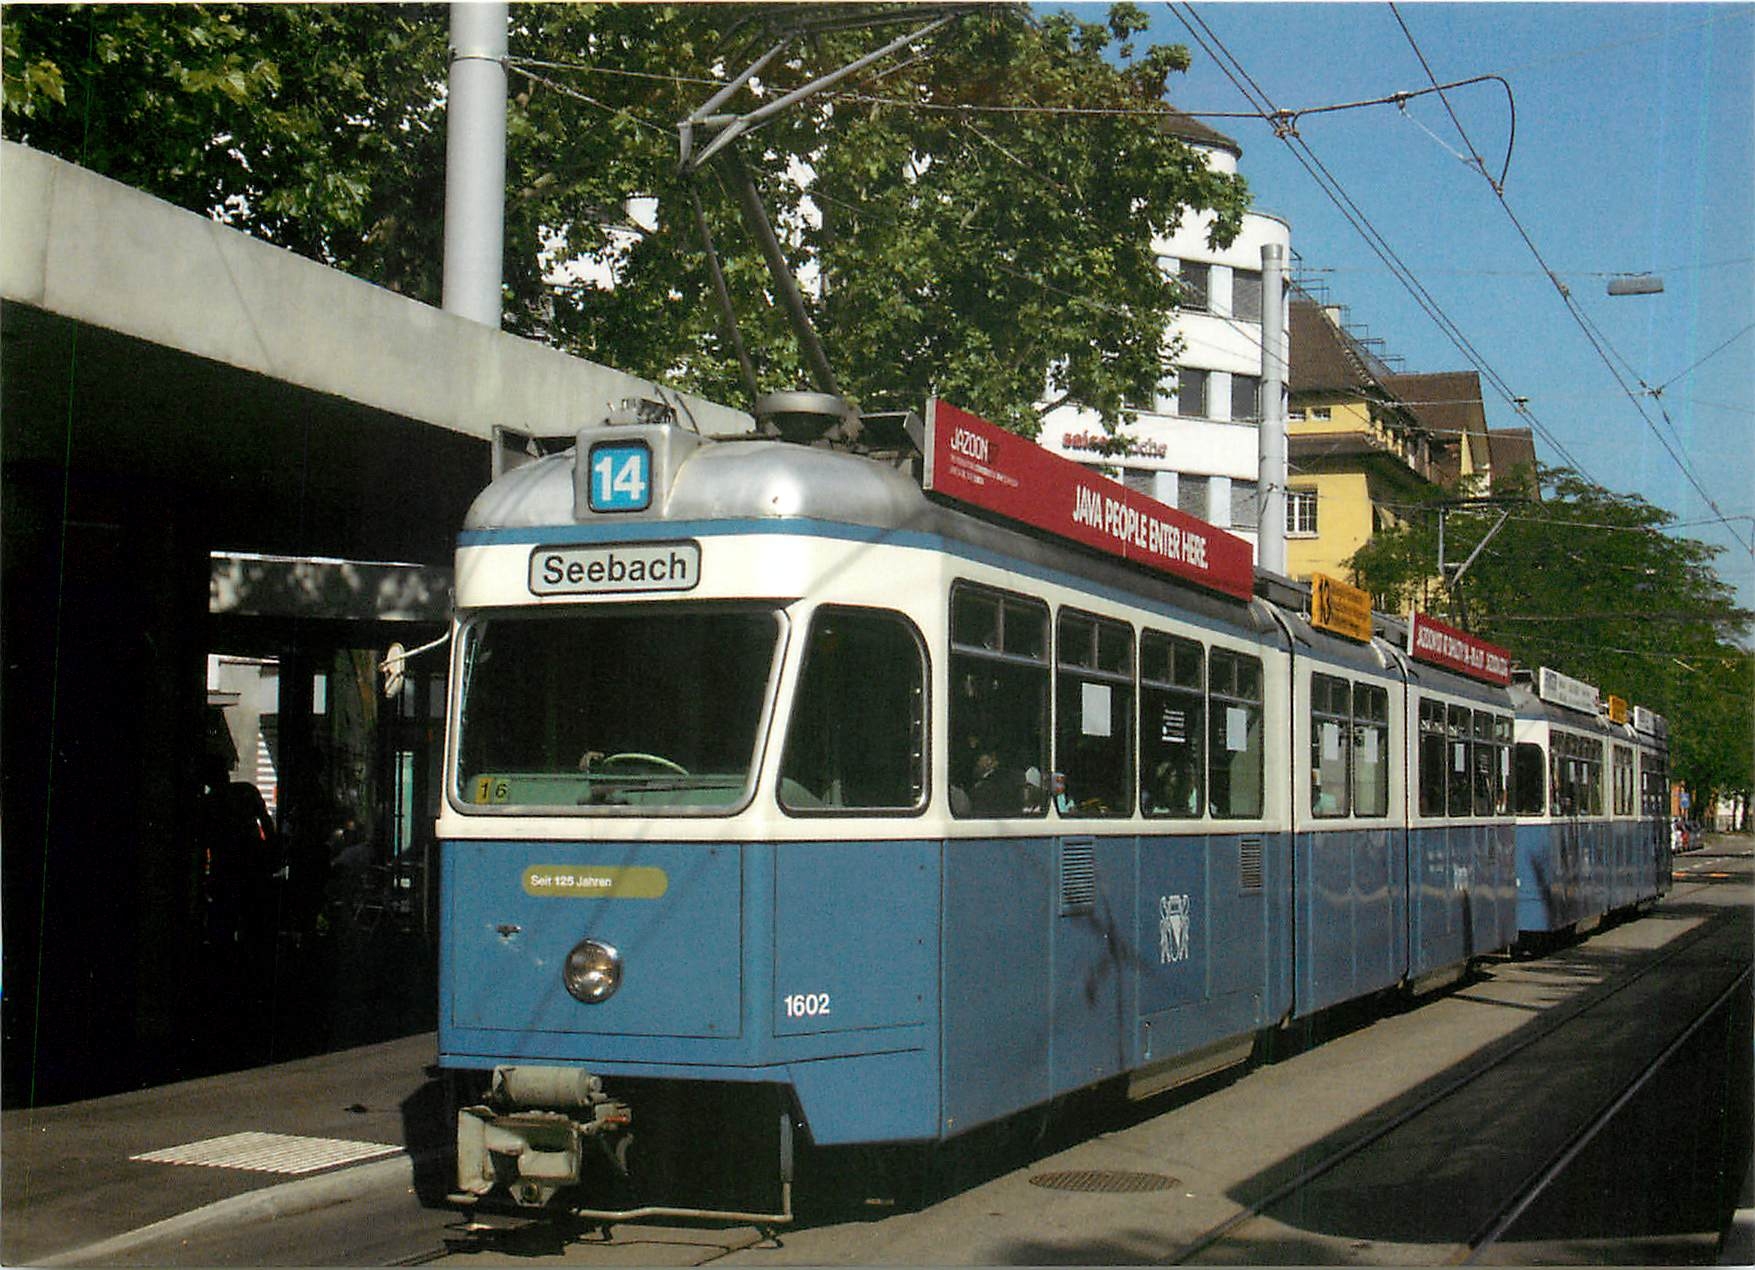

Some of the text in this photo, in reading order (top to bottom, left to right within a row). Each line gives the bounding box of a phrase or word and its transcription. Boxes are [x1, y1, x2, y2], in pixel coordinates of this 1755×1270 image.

[950, 426, 989, 463] JAZOON
[595, 455, 646, 501] 14
[1072, 484, 1103, 529] JAVA
[1105, 497, 1147, 548] PEOPLE
[1149, 517, 1181, 560] ENTER
[543, 552, 687, 584] Seebach
[530, 874, 612, 888] Seit 125 Jahren
[784, 993, 830, 1017] 1602
